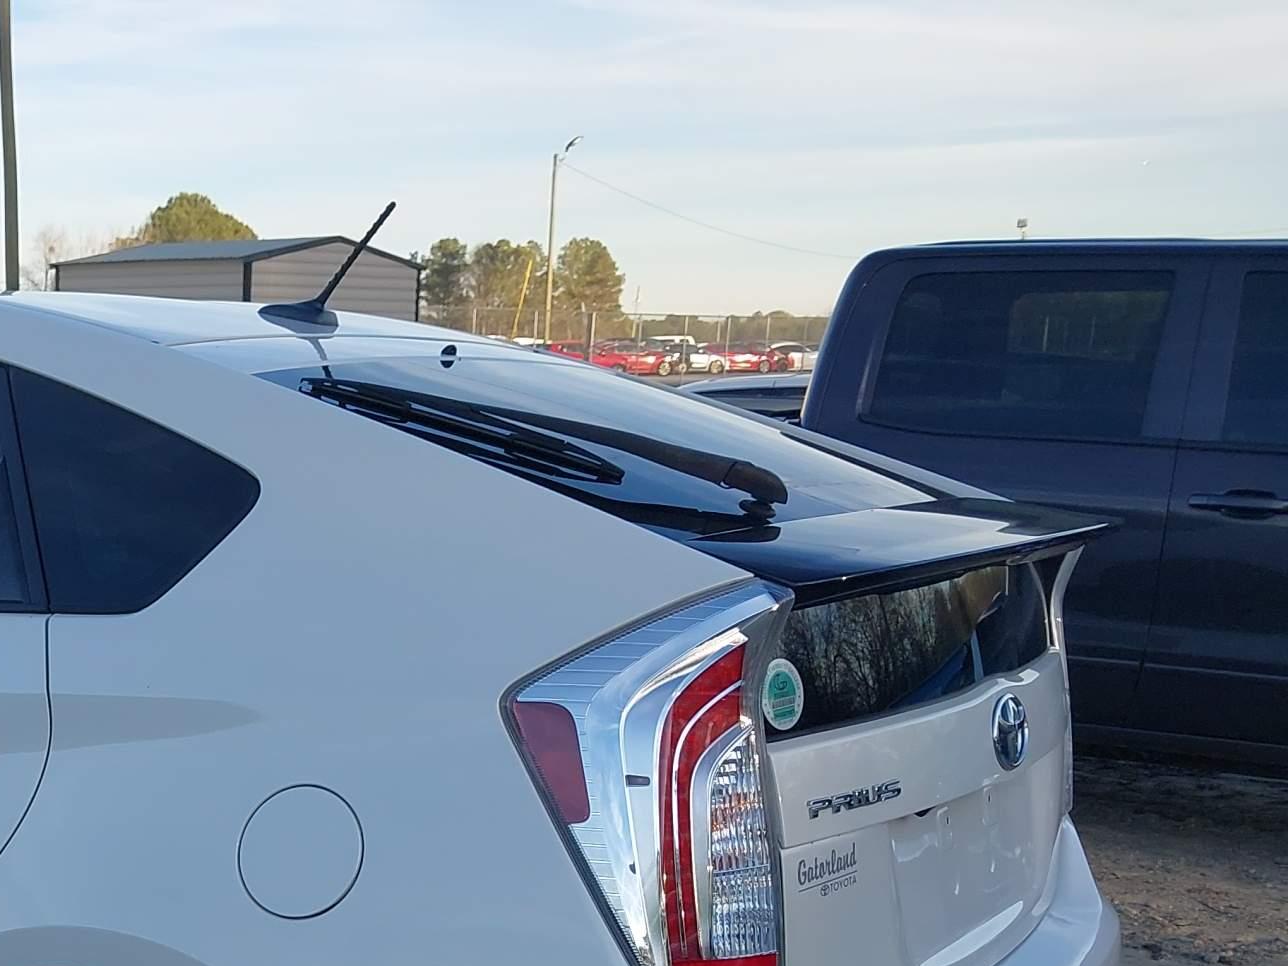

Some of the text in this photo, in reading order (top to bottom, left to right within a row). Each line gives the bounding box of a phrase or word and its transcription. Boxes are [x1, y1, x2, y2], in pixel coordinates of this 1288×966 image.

[807, 779, 902, 819] PRIUS
[797, 842, 857, 886] Gatorland
[829, 875, 857, 893] TOYOTA
